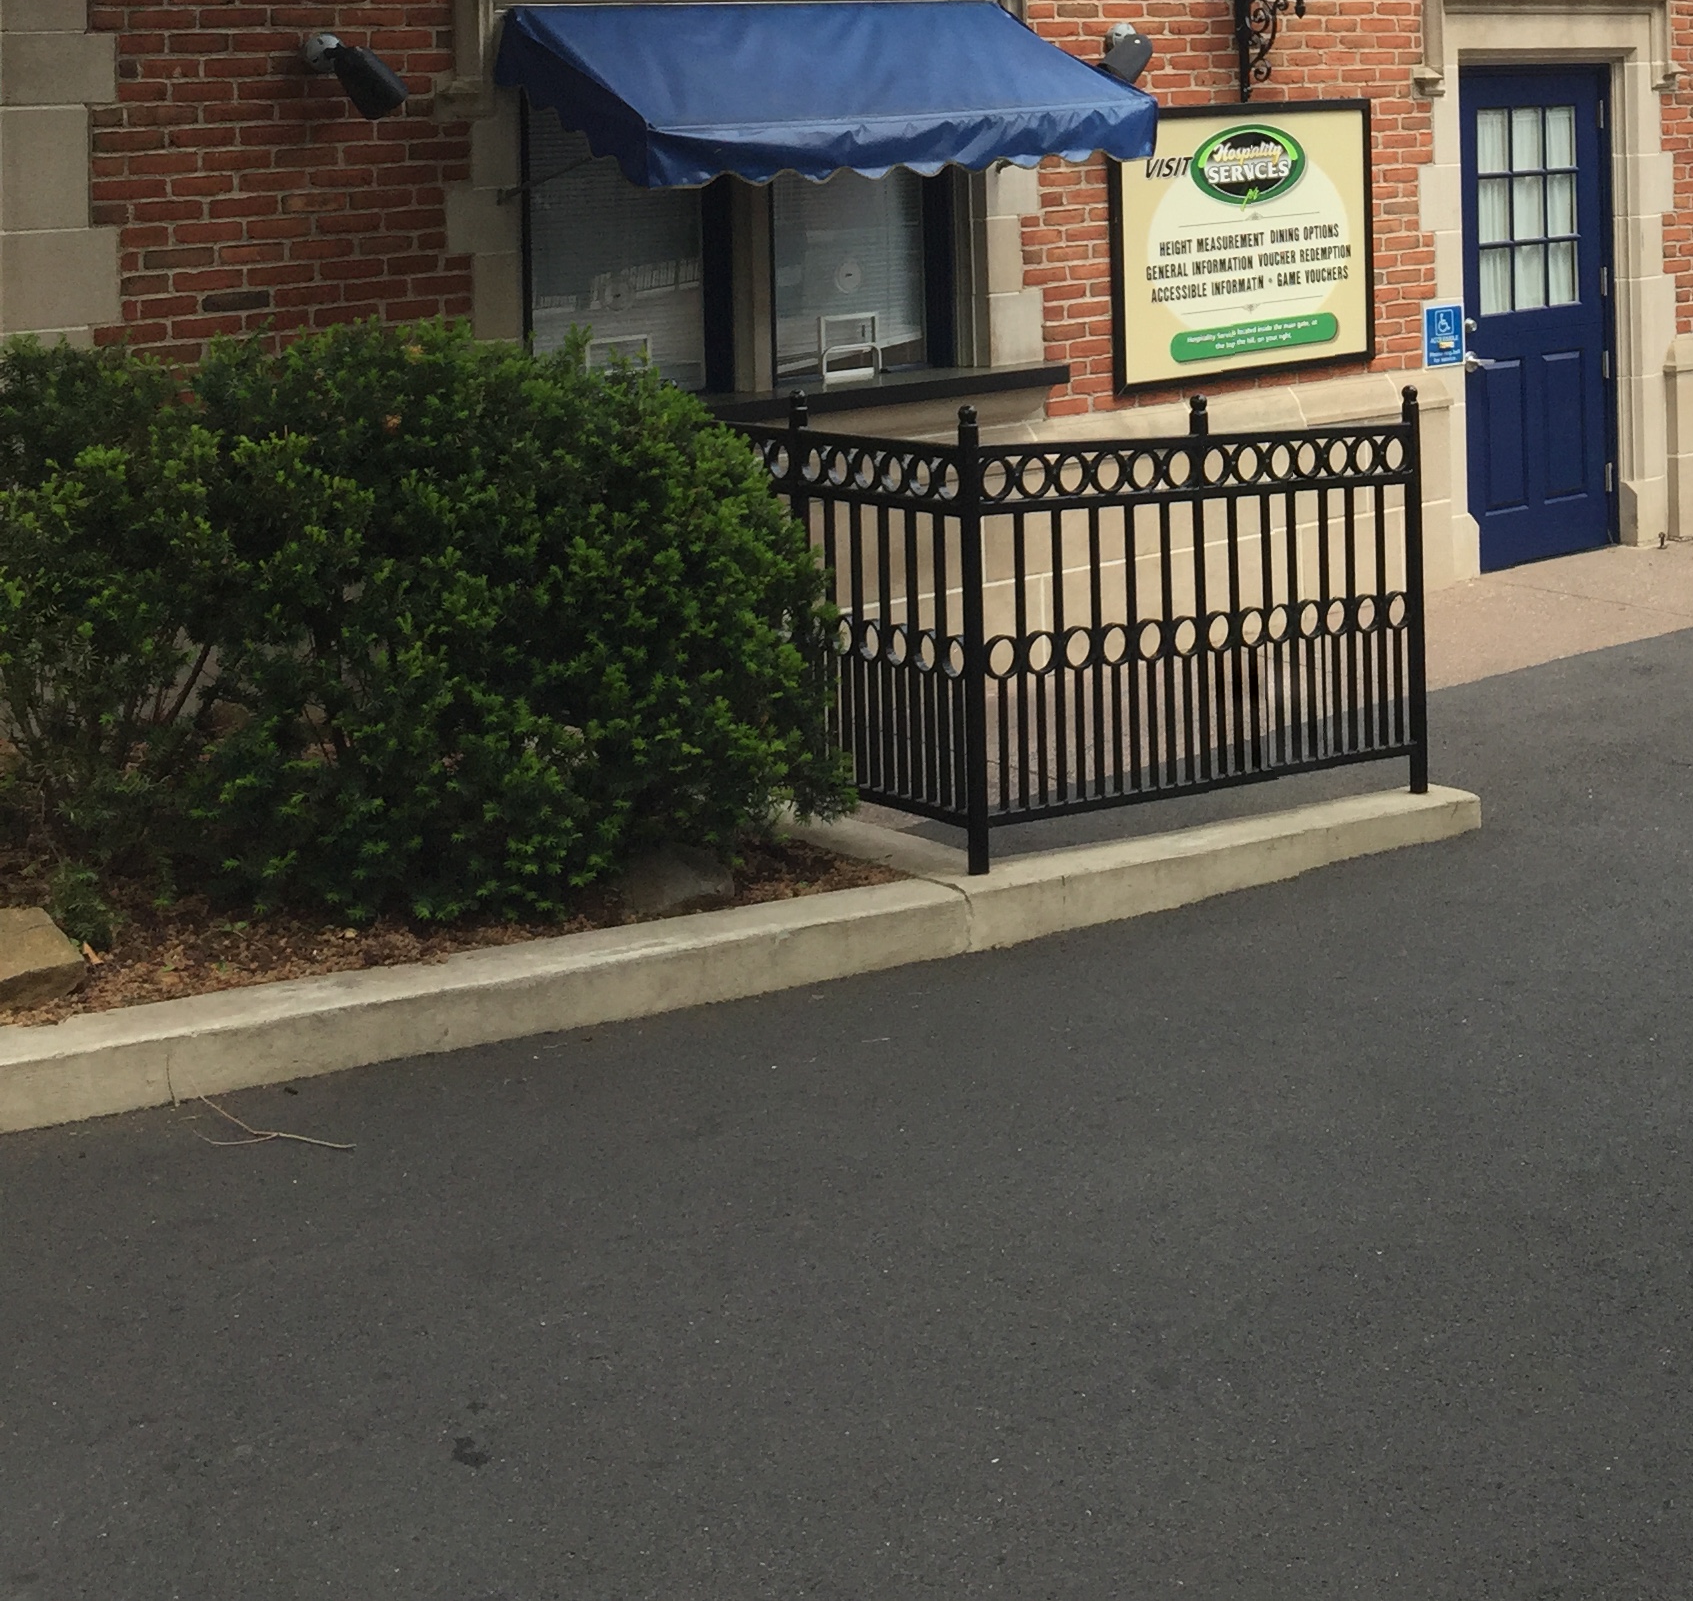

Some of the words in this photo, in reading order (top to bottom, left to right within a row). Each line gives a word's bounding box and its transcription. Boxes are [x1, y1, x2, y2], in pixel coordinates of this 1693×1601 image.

[1145, 156, 1193, 179] VISIT
[1159, 239, 1193, 257] HEIGHT
[1197, 232, 1264, 253] MEASUREMENT
[1270, 227, 1300, 244] DINING
[1304, 223, 1339, 241] OPTIONS
[1146, 263, 1188, 281] GENERAL
[1192, 255, 1254, 276] INFORMATION
[1258, 250, 1296, 267] VOUCHER
[1300, 244, 1351, 263] REDEMPTION
[1151, 282, 1207, 303] ACCESSIBLE
[1277, 271, 1301, 287] GAME
[1305, 265, 1349, 284] VOUCHERS
